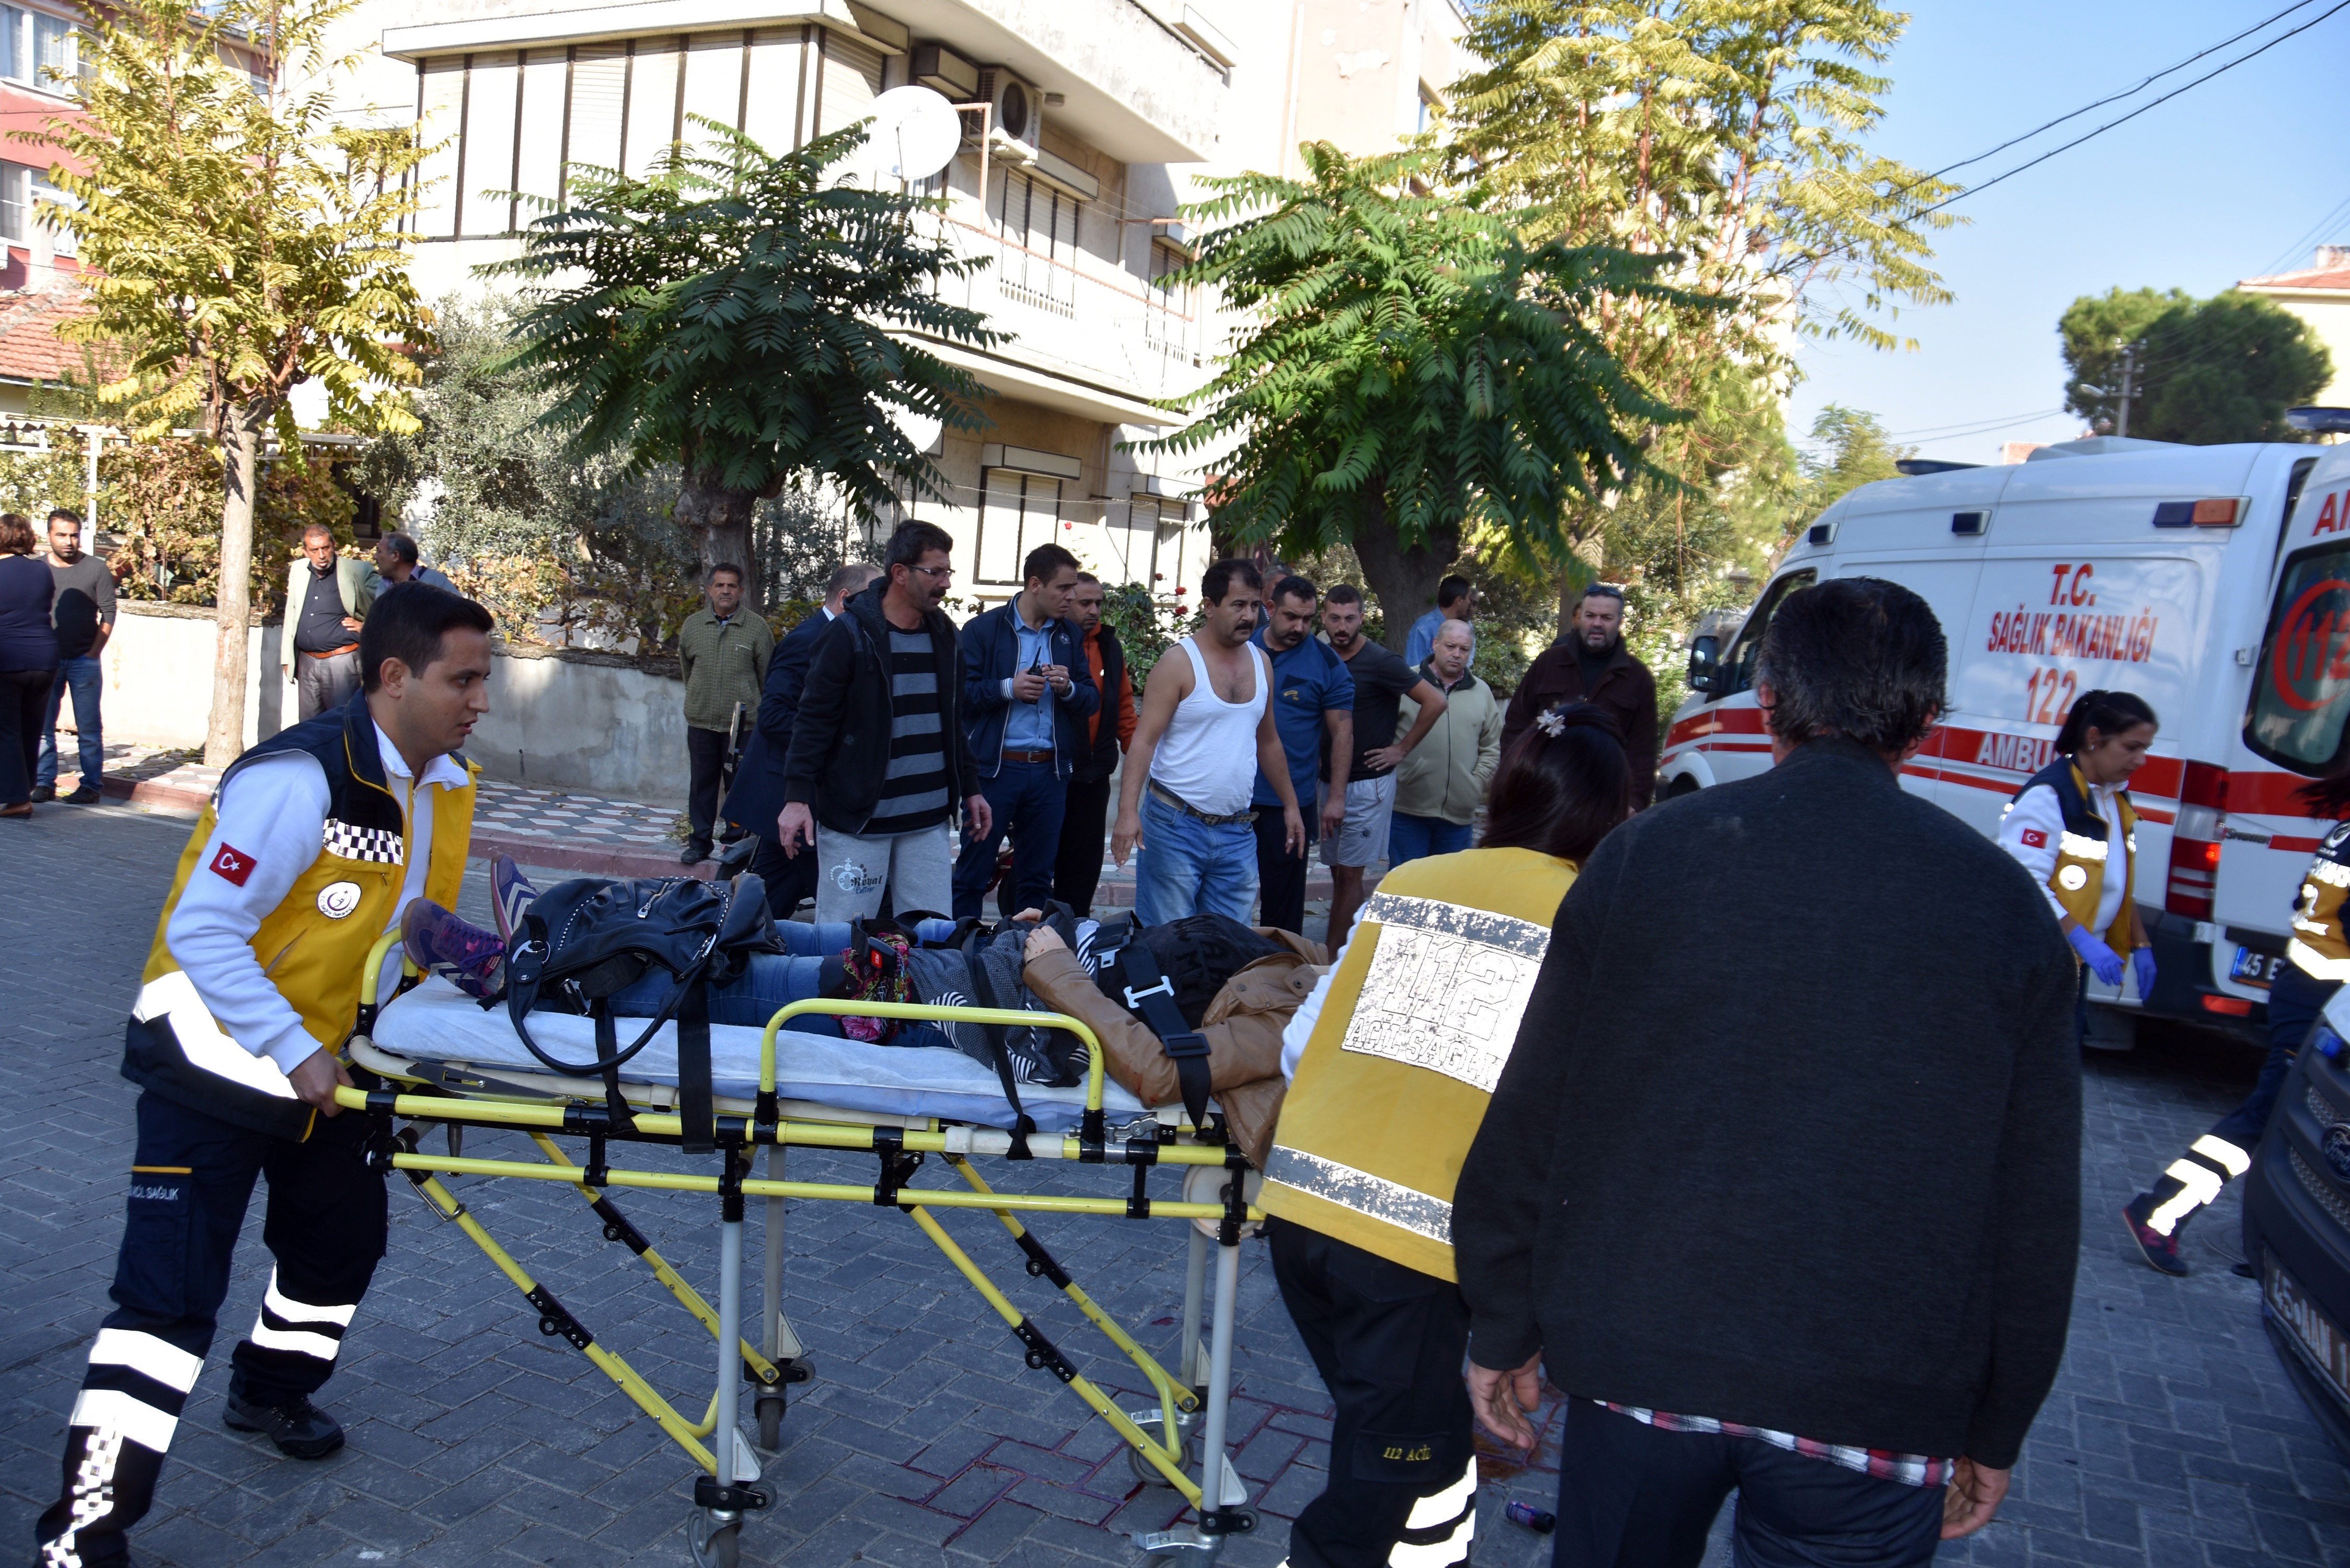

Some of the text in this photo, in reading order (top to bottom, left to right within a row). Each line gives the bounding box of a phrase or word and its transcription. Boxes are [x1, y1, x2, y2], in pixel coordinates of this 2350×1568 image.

[2051, 563, 2097, 606] T.C.
[1988, 603, 2159, 663] SAĞLIK BAKANLIĞI
[2027, 666, 2077, 726] 122
[1977, 733, 2061, 773] AMBU
[851, 875, 883, 887] Royal
[1381, 933, 1518, 1041] 112
[2266, 957, 2285, 980] E
[1345, 1014, 1400, 1056] ACİL
[146, 1185, 179, 1201] SAĞLIK
[1383, 1444, 1432, 1461] 112 ACİL
